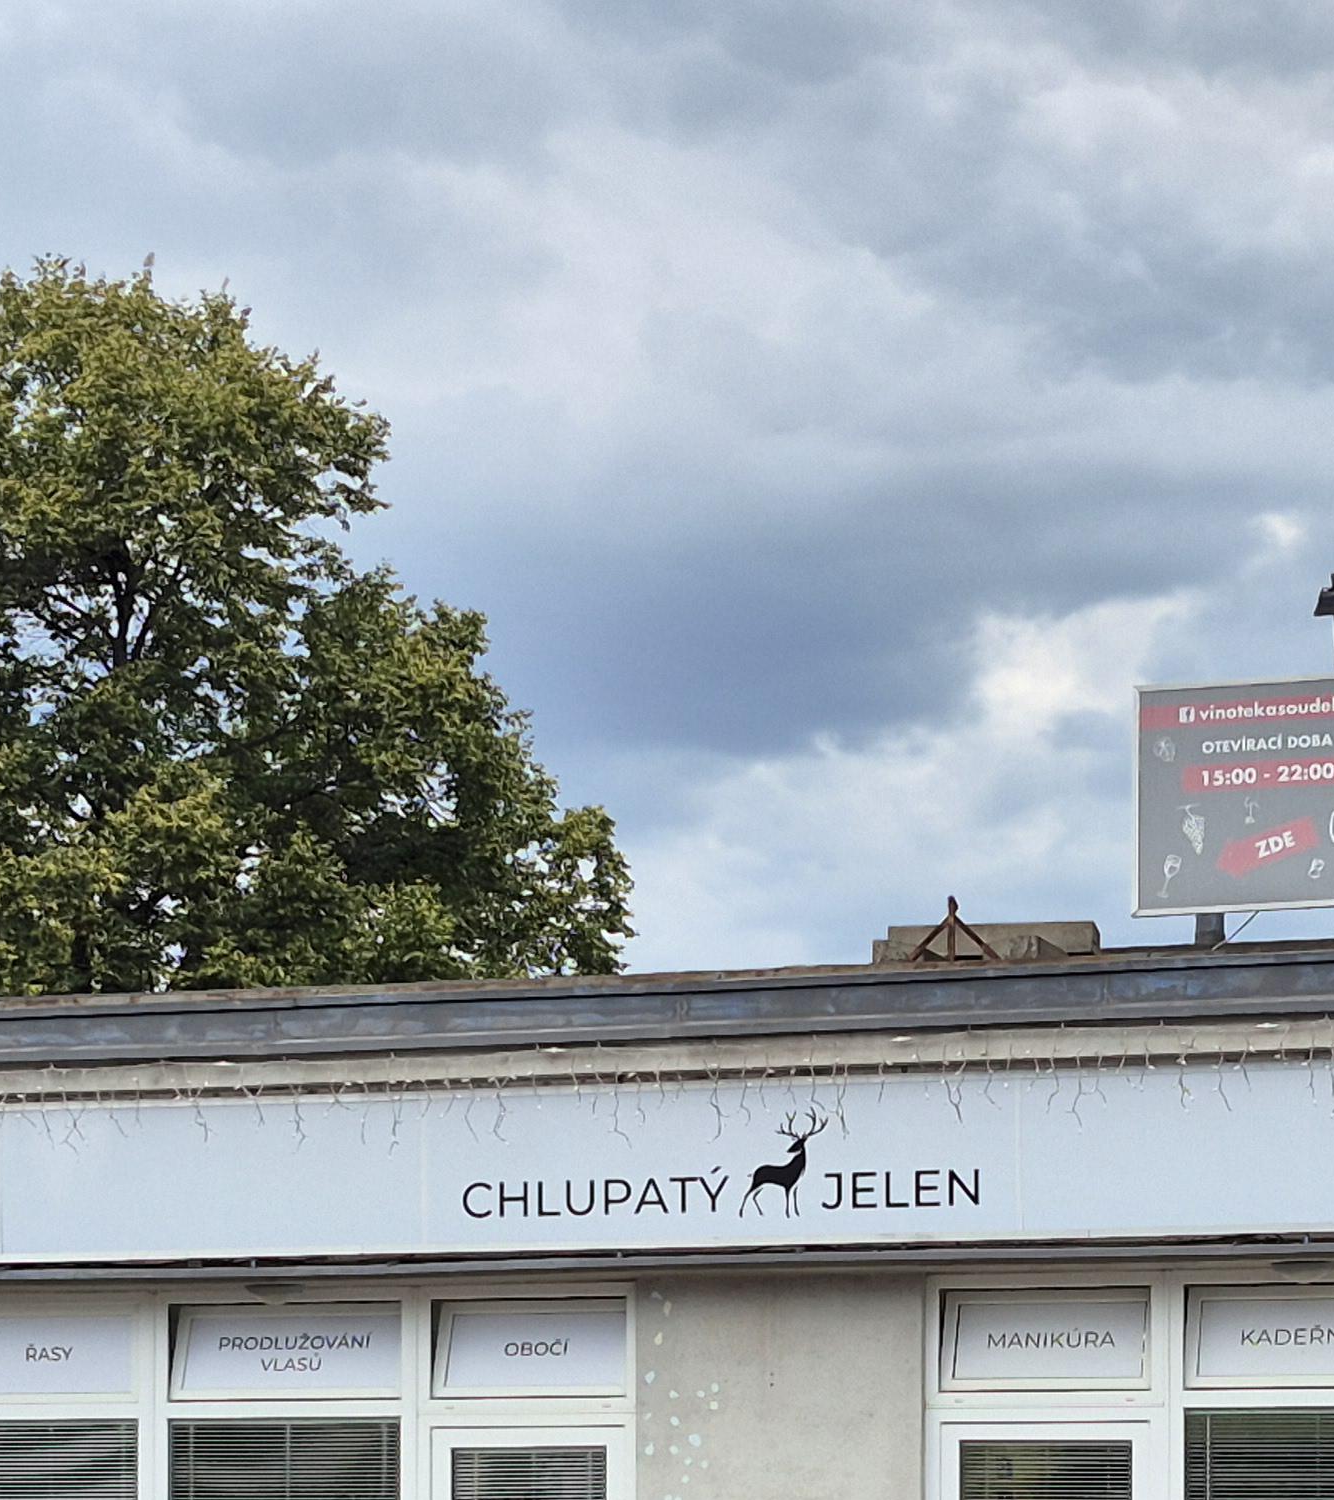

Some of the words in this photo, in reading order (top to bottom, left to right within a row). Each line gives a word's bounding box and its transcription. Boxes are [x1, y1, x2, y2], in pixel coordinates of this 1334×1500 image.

[1201, 733, 1283, 754] OTEVÍRACÍ
[1287, 733, 1333, 750] DOBA
[1201, 767, 1257, 786] 15:00
[1254, 831, 1297, 859] ZDE
[462, 1166, 729, 1219] CHLUPATÝ
[821, 1168, 980, 1210] JELEN
[218, 1331, 372, 1351] PRODLUŽOVÁNÍ
[504, 1338, 570, 1357] OBOČÍ
[987, 1328, 1116, 1349] MANIKÚRA
[25, 1343, 74, 1362] ŘASY
[260, 1352, 323, 1372] VLASŮ
